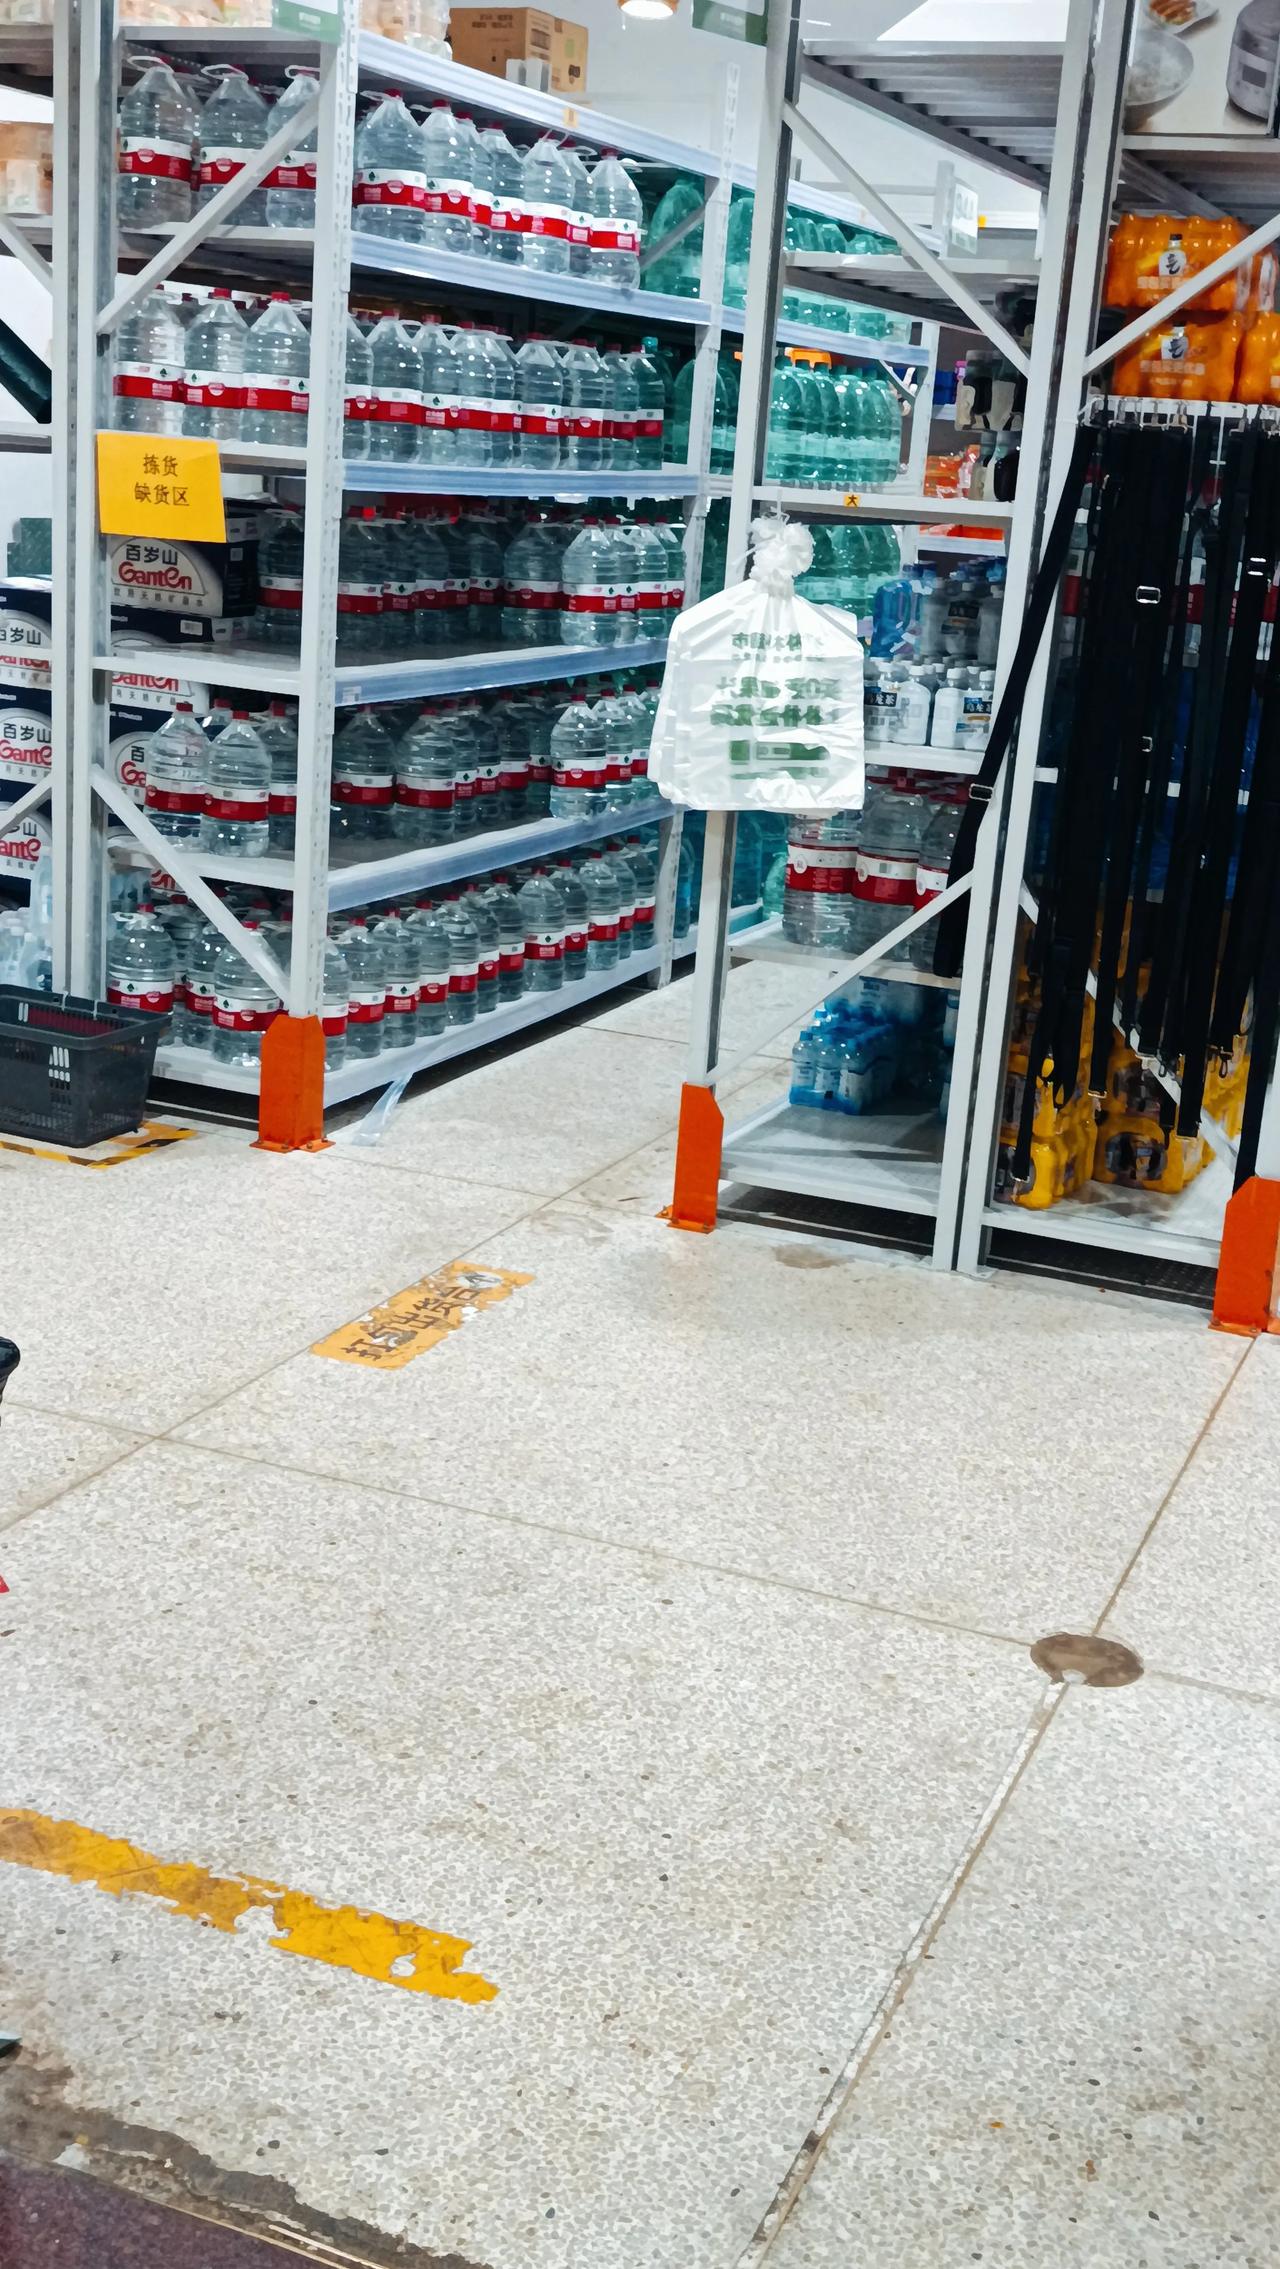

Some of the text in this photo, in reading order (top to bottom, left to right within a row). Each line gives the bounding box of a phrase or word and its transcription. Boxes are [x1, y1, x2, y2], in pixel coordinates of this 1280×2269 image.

[142, 453, 178, 477] 拣货
[134, 482, 190, 507] 缺货区
[126, 544, 178, 566] 百岁山
[3, 723, 52, 743] 百岁山
[0, 740, 52, 766] Gante
